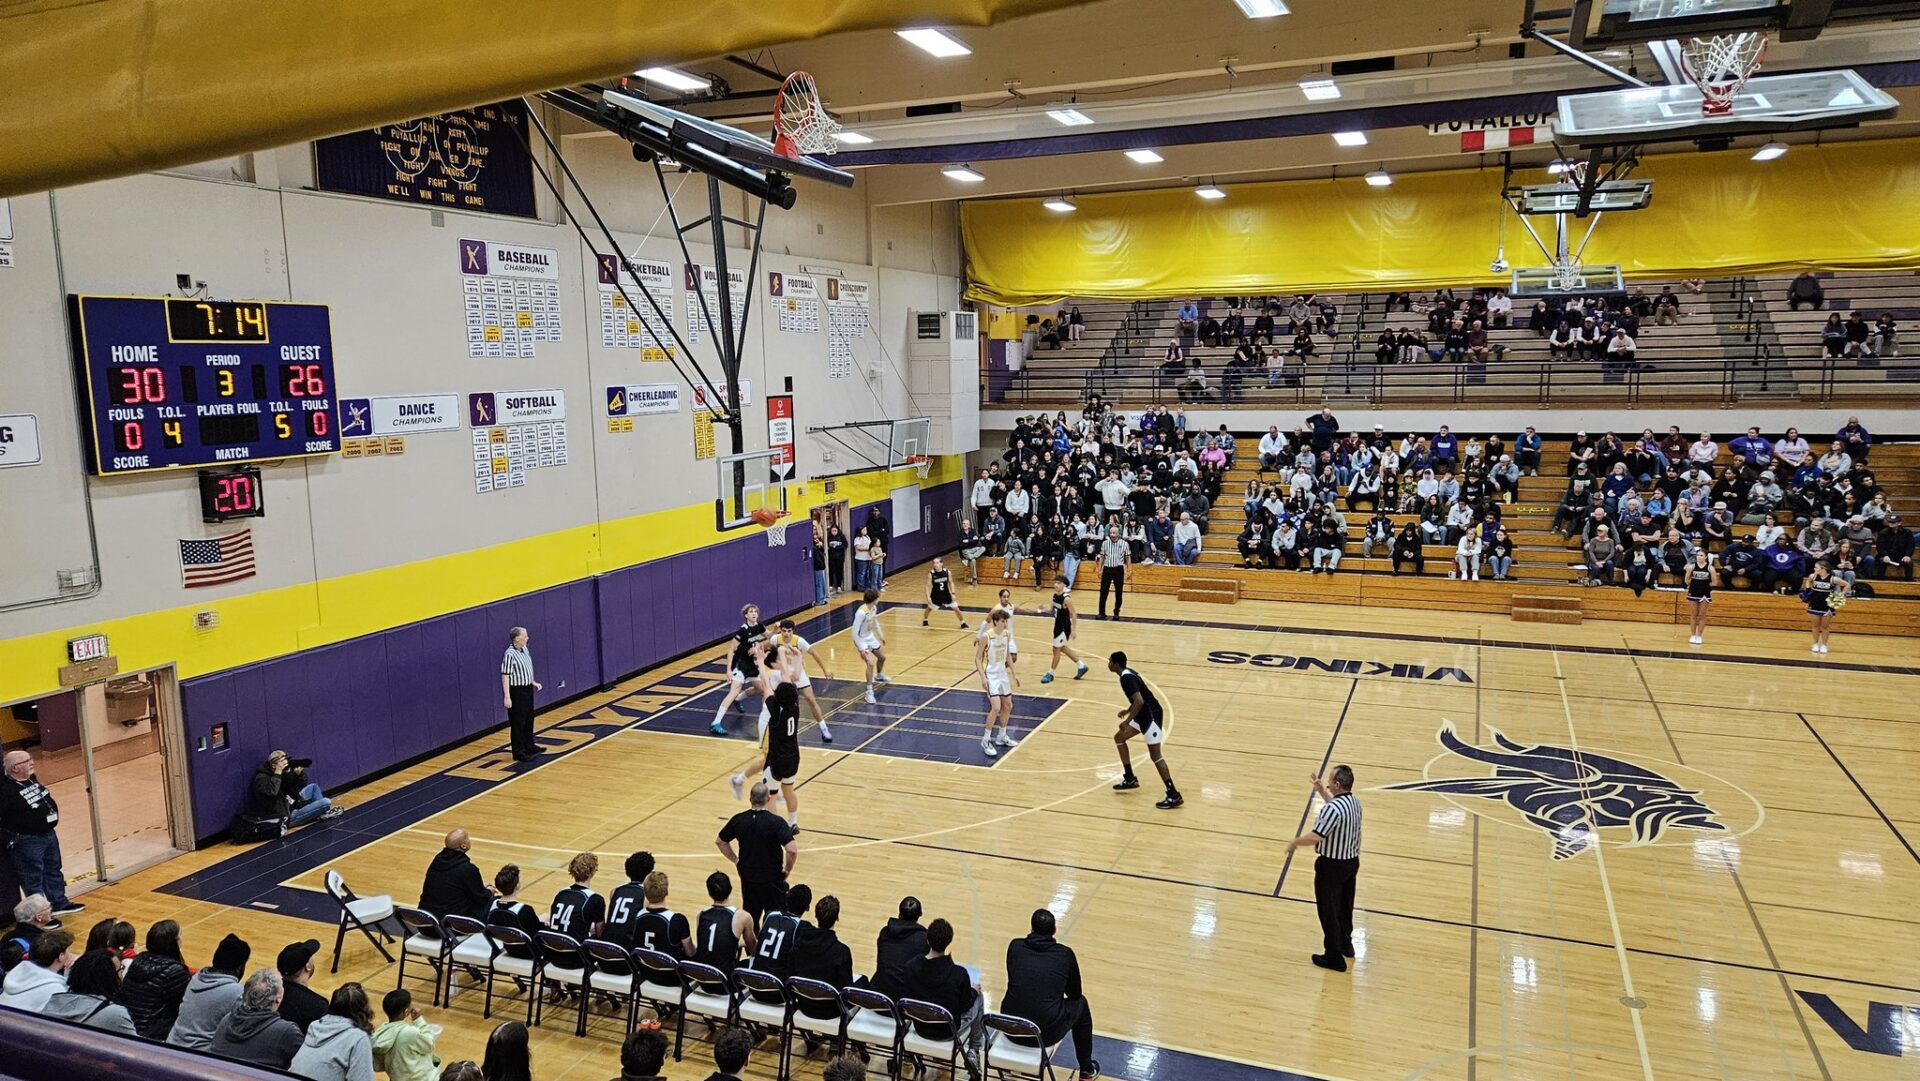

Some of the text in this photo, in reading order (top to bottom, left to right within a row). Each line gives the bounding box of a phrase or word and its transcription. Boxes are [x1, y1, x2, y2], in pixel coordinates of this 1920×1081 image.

[428, 177, 448, 189] FIGHT
[441, 193, 456, 203] THIS
[498, 250, 550, 266] BASEBALL
[504, 263, 545, 274] CHAMPIONS
[620, 262, 670, 277] BSKETBALL
[704, 270, 743, 283] VOLBALL
[788, 279, 813, 289] FOOTBALL
[196, 304, 264, 336] 7:14
[111, 345, 159, 363] HOME
[206, 355, 241, 366] PERIOD
[280, 345, 321, 361] GUEST
[121, 368, 165, 403] 30
[218, 370, 235, 396] 3
[289, 365, 324, 397] 26
[505, 395, 557, 410] SOFTBALL
[629, 389, 678, 402] CHEERLEADING
[197, 403, 262, 416] PLAYER FOUL
[269, 401, 294, 412] T.O.L.
[302, 400, 329, 410] FOULS
[399, 402, 435, 416] DANCE
[639, 400, 670, 408] CHAMPIONS
[108, 408, 144, 421] FOULS
[157, 406, 186, 418] T.O.L.
[512, 408, 552, 418] CHAMPIONS
[275, 414, 292, 438] 5
[313, 411, 328, 436] 0
[392, 416, 443, 427] CHAMPIONS
[124, 423, 143, 450] 0
[164, 421, 182, 445] 4
[216, 447, 249, 460] MATCH
[305, 441, 332, 452] SCORE
[113, 456, 150, 469] SCORE
[215, 477, 252, 512] 20
[939, 582, 945, 591] 2
[76, 639, 102, 658] EXIT
[1207, 651, 1474, 683] VIKINGS
[787, 716, 795, 737] 0
[551, 903, 575, 932] 24
[610, 897, 634, 924] 15
[644, 931, 656, 951] 5
[707, 923, 717, 951] 1
[759, 928, 786, 959] 21
